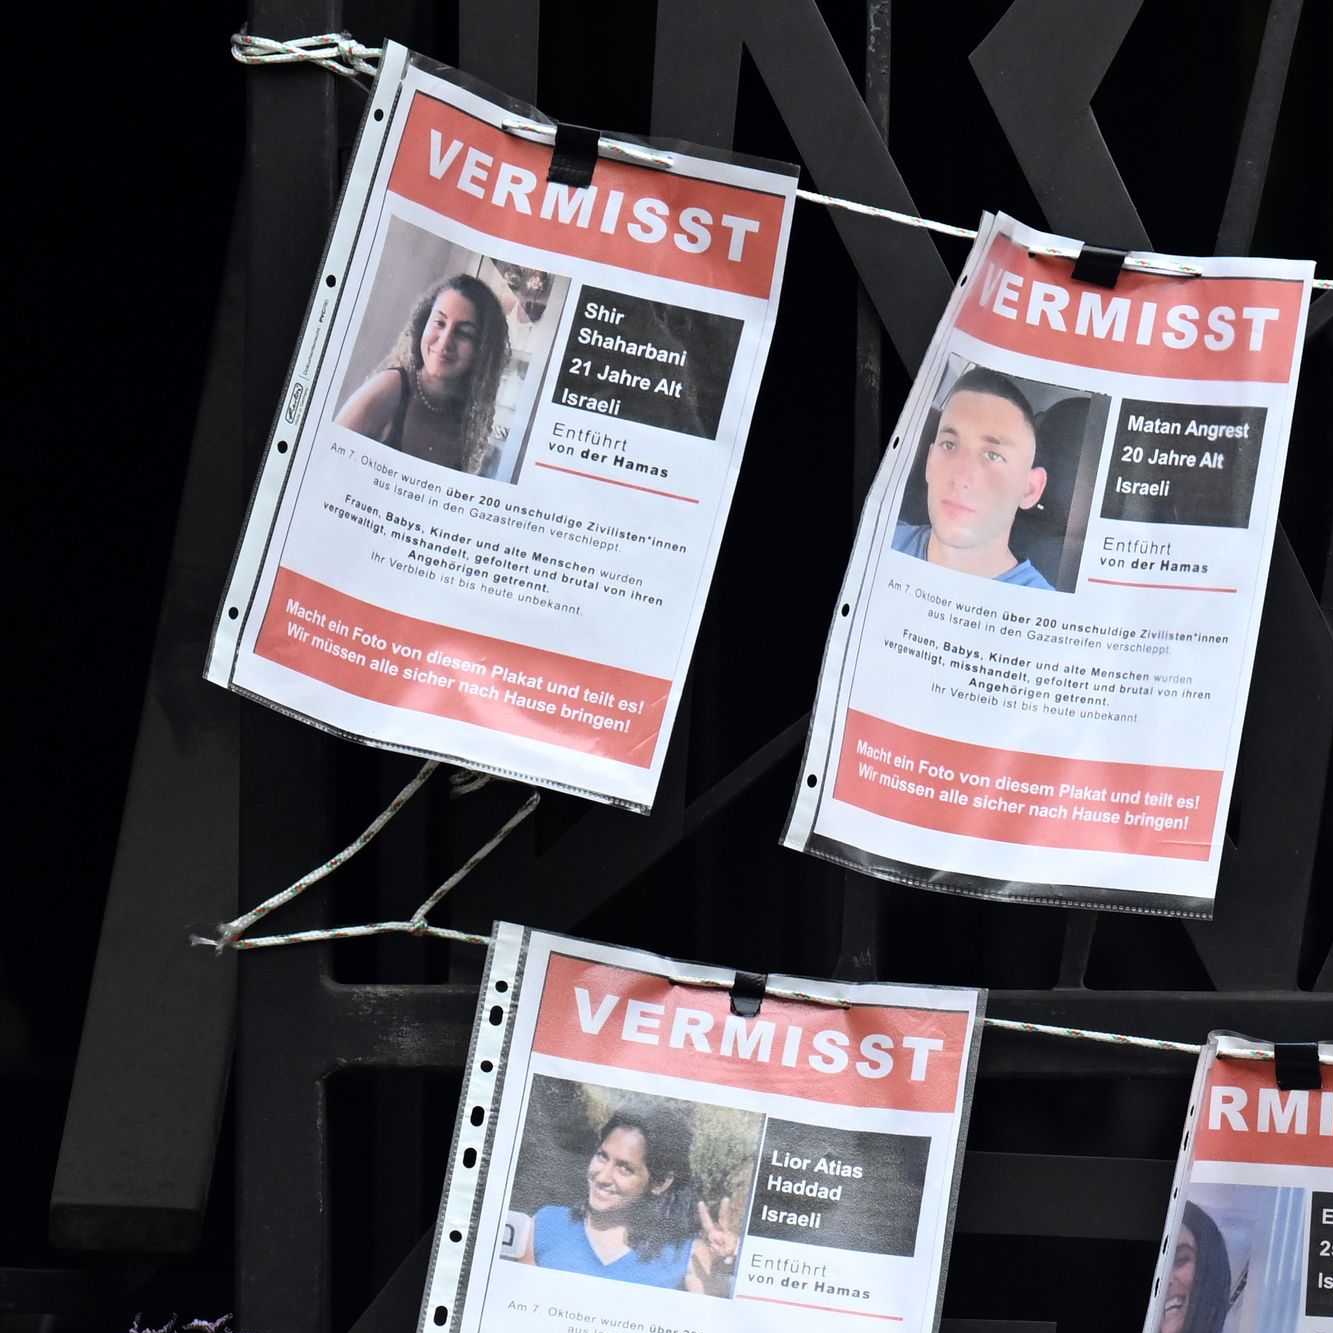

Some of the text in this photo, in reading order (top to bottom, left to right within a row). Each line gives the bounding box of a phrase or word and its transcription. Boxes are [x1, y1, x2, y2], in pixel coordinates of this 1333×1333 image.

[429, 128, 760, 262] VERMISST
[584, 302, 625, 325] Shir
[980, 263, 1280, 352] VERMISST
[578, 327, 687, 367] Shaharbani
[569, 358, 683, 398] 21 Jahre Alt
[562, 388, 621, 415] Israeli
[552, 422, 627, 452] Entführt
[1127, 415, 1250, 441] Matan Angrest
[549, 442, 668, 478] von der Hamas
[1121, 446, 1224, 469] 20 Jahre Alt
[1116, 476, 1170, 496] Israeli
[575, 987, 944, 1081] VERMISST
[771, 1149, 863, 1179] Lior Atias
[767, 1175, 843, 1201] Haddad
[761, 1206, 821, 1230] Israeli
